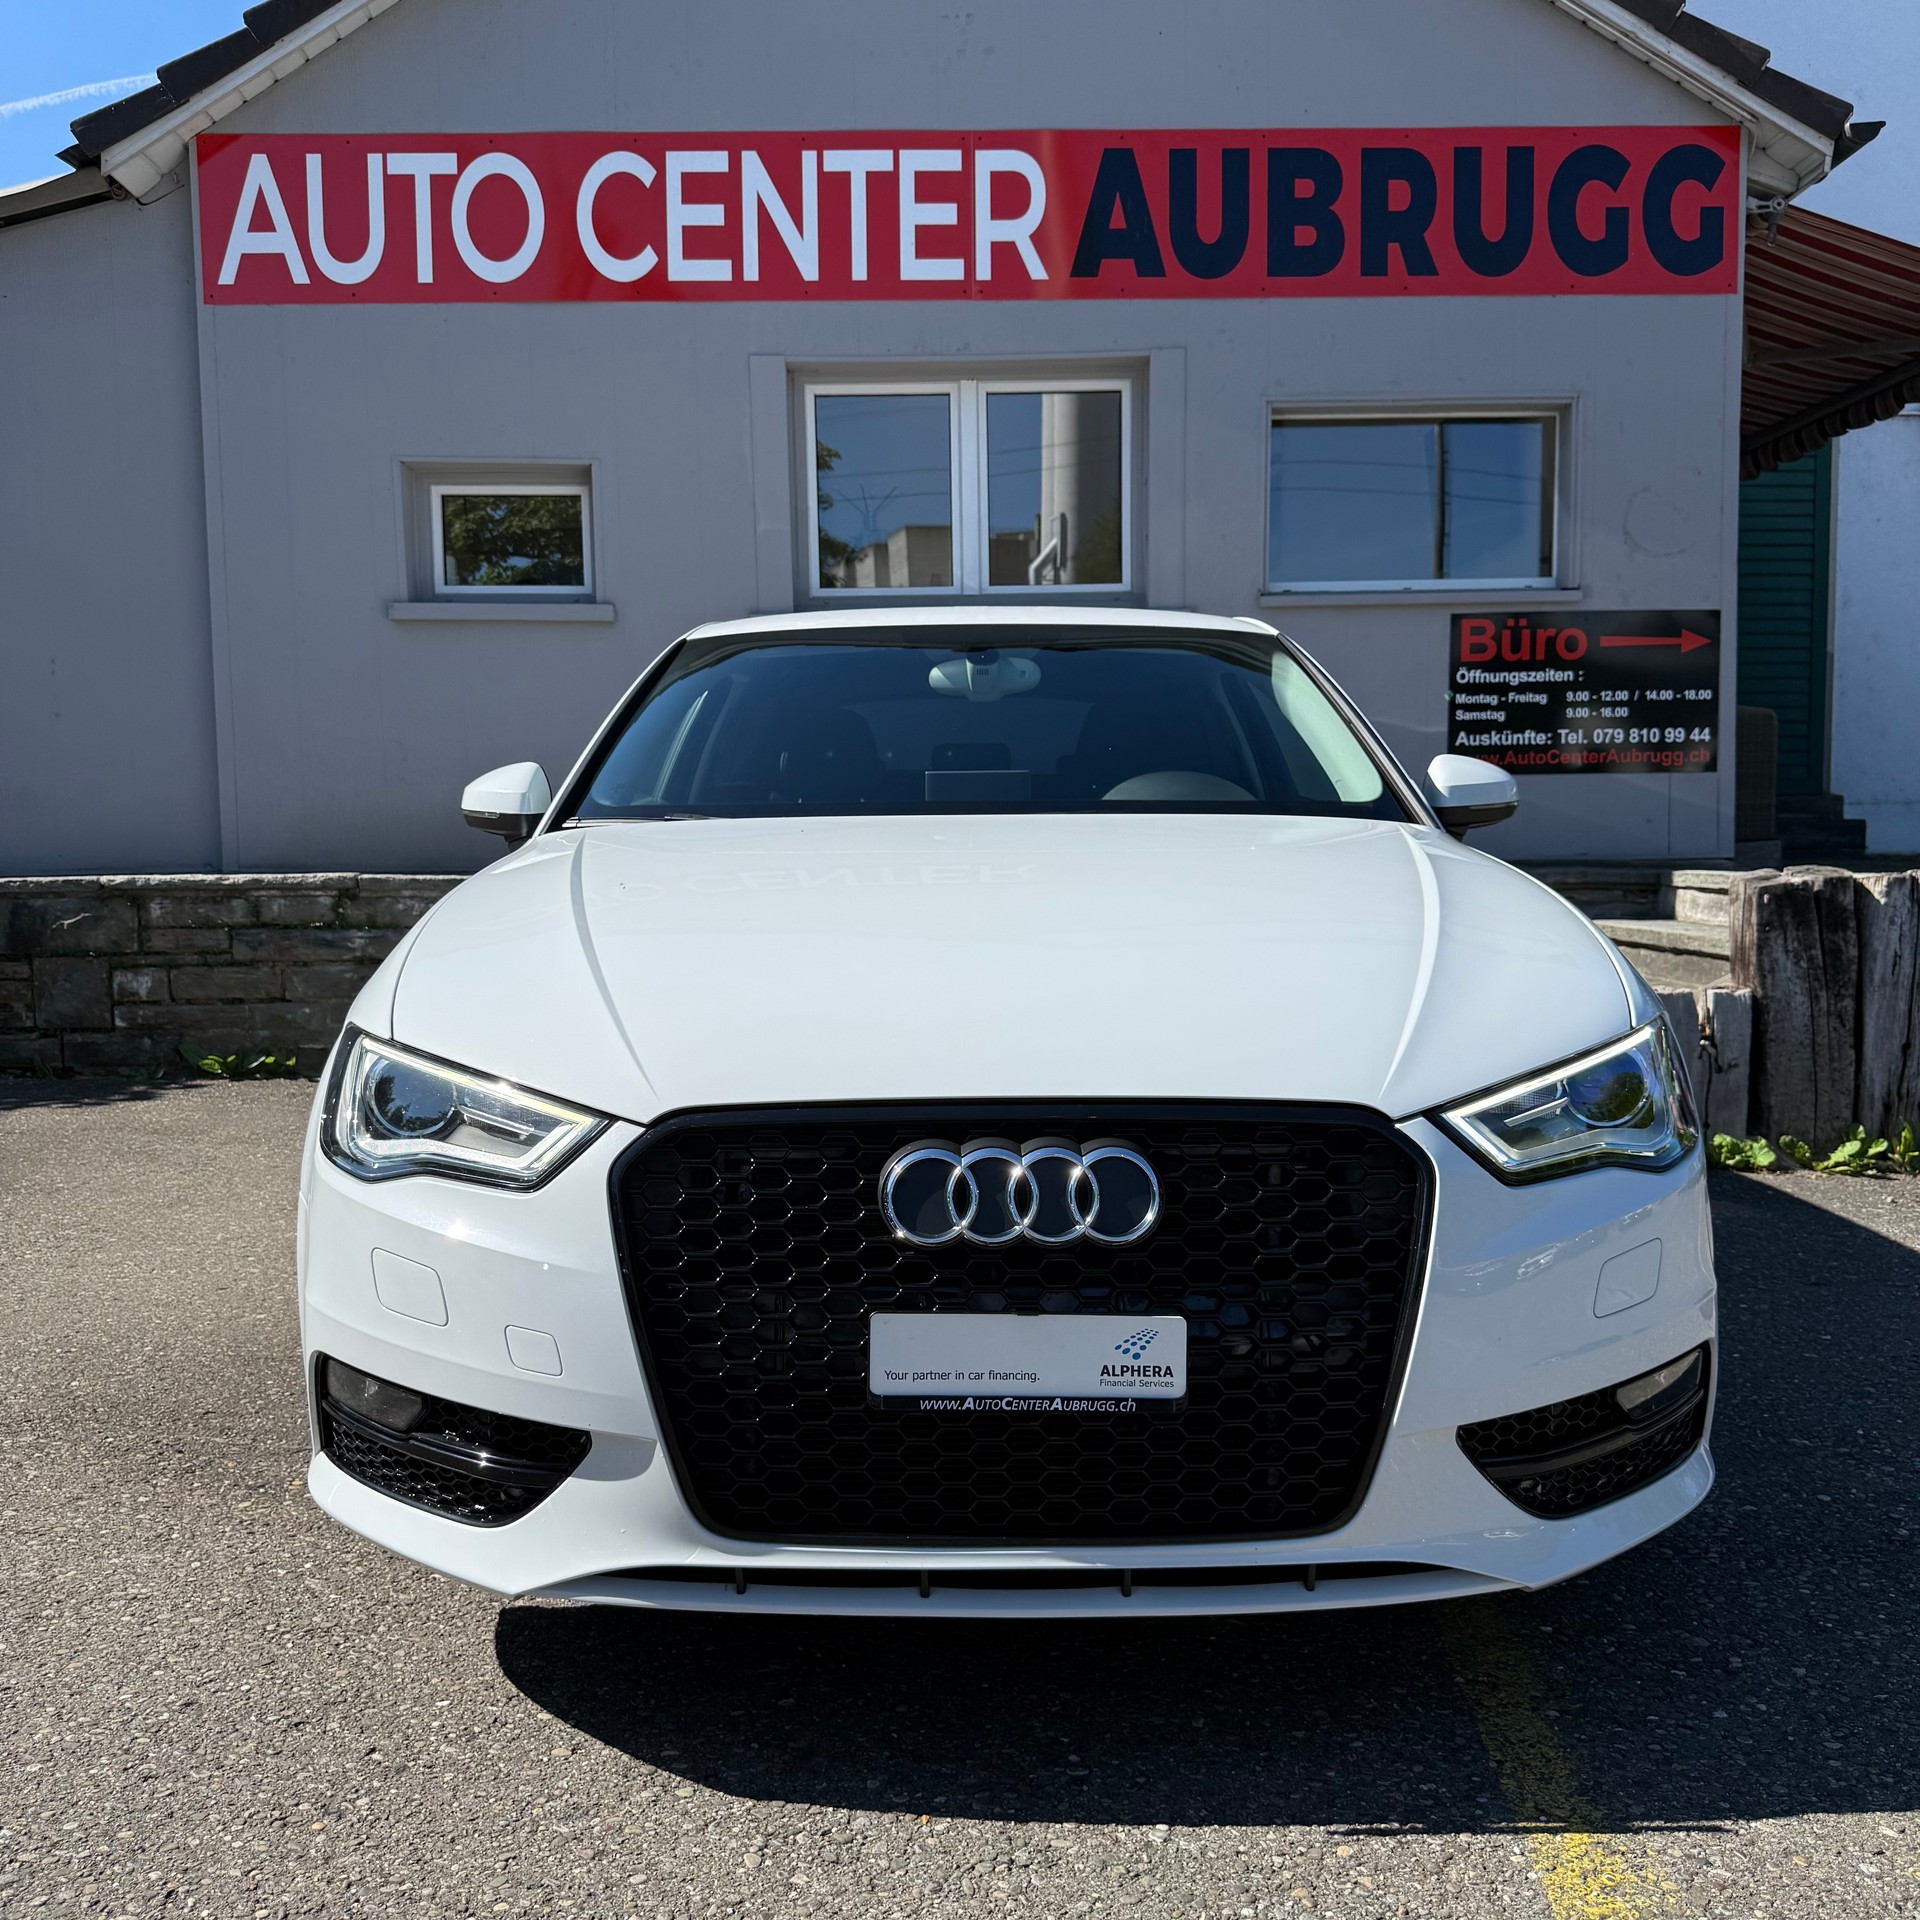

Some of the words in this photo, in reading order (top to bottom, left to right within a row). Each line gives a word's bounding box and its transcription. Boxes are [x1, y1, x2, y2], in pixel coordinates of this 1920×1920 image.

[218, 151, 546, 286] AUTO
[576, 148, 1049, 284] CENTER
[1069, 144, 1727, 281] AUBRUGG
[1460, 618, 1588, 663] Büro
[1456, 666, 1574, 686] Öffnungszeiten
[1455, 693, 1499, 706] Montag
[1508, 692, 1549, 705] Freitag
[1566, 690, 1589, 702] 9.00
[1600, 690, 1629, 701] 12.00
[1645, 689, 1673, 701] 14.00
[1684, 689, 1712, 700] 18.00
[1455, 709, 1506, 722] Samstag
[1566, 706, 1589, 718] 9.00
[1600, 706, 1629, 718] 16.00
[1455, 729, 1552, 747] Auskünfte:
[1557, 728, 1588, 745] Tel.
[1593, 727, 1624, 744] 079
[1629, 727, 1660, 744] 810
[1664, 727, 1686, 743] 99
[1689, 726, 1711, 743] 44
[884, 1370, 909, 1381] Your
[912, 1370, 952, 1383] partner
[955, 1370, 965, 1381] in
[968, 1372, 986, 1381] car
[988, 1370, 1040, 1383] financing.
[1099, 1364, 1174, 1378] ALPHERA
[1099, 1379, 1136, 1388] Financial
[1138, 1379, 1175, 1388] Services
